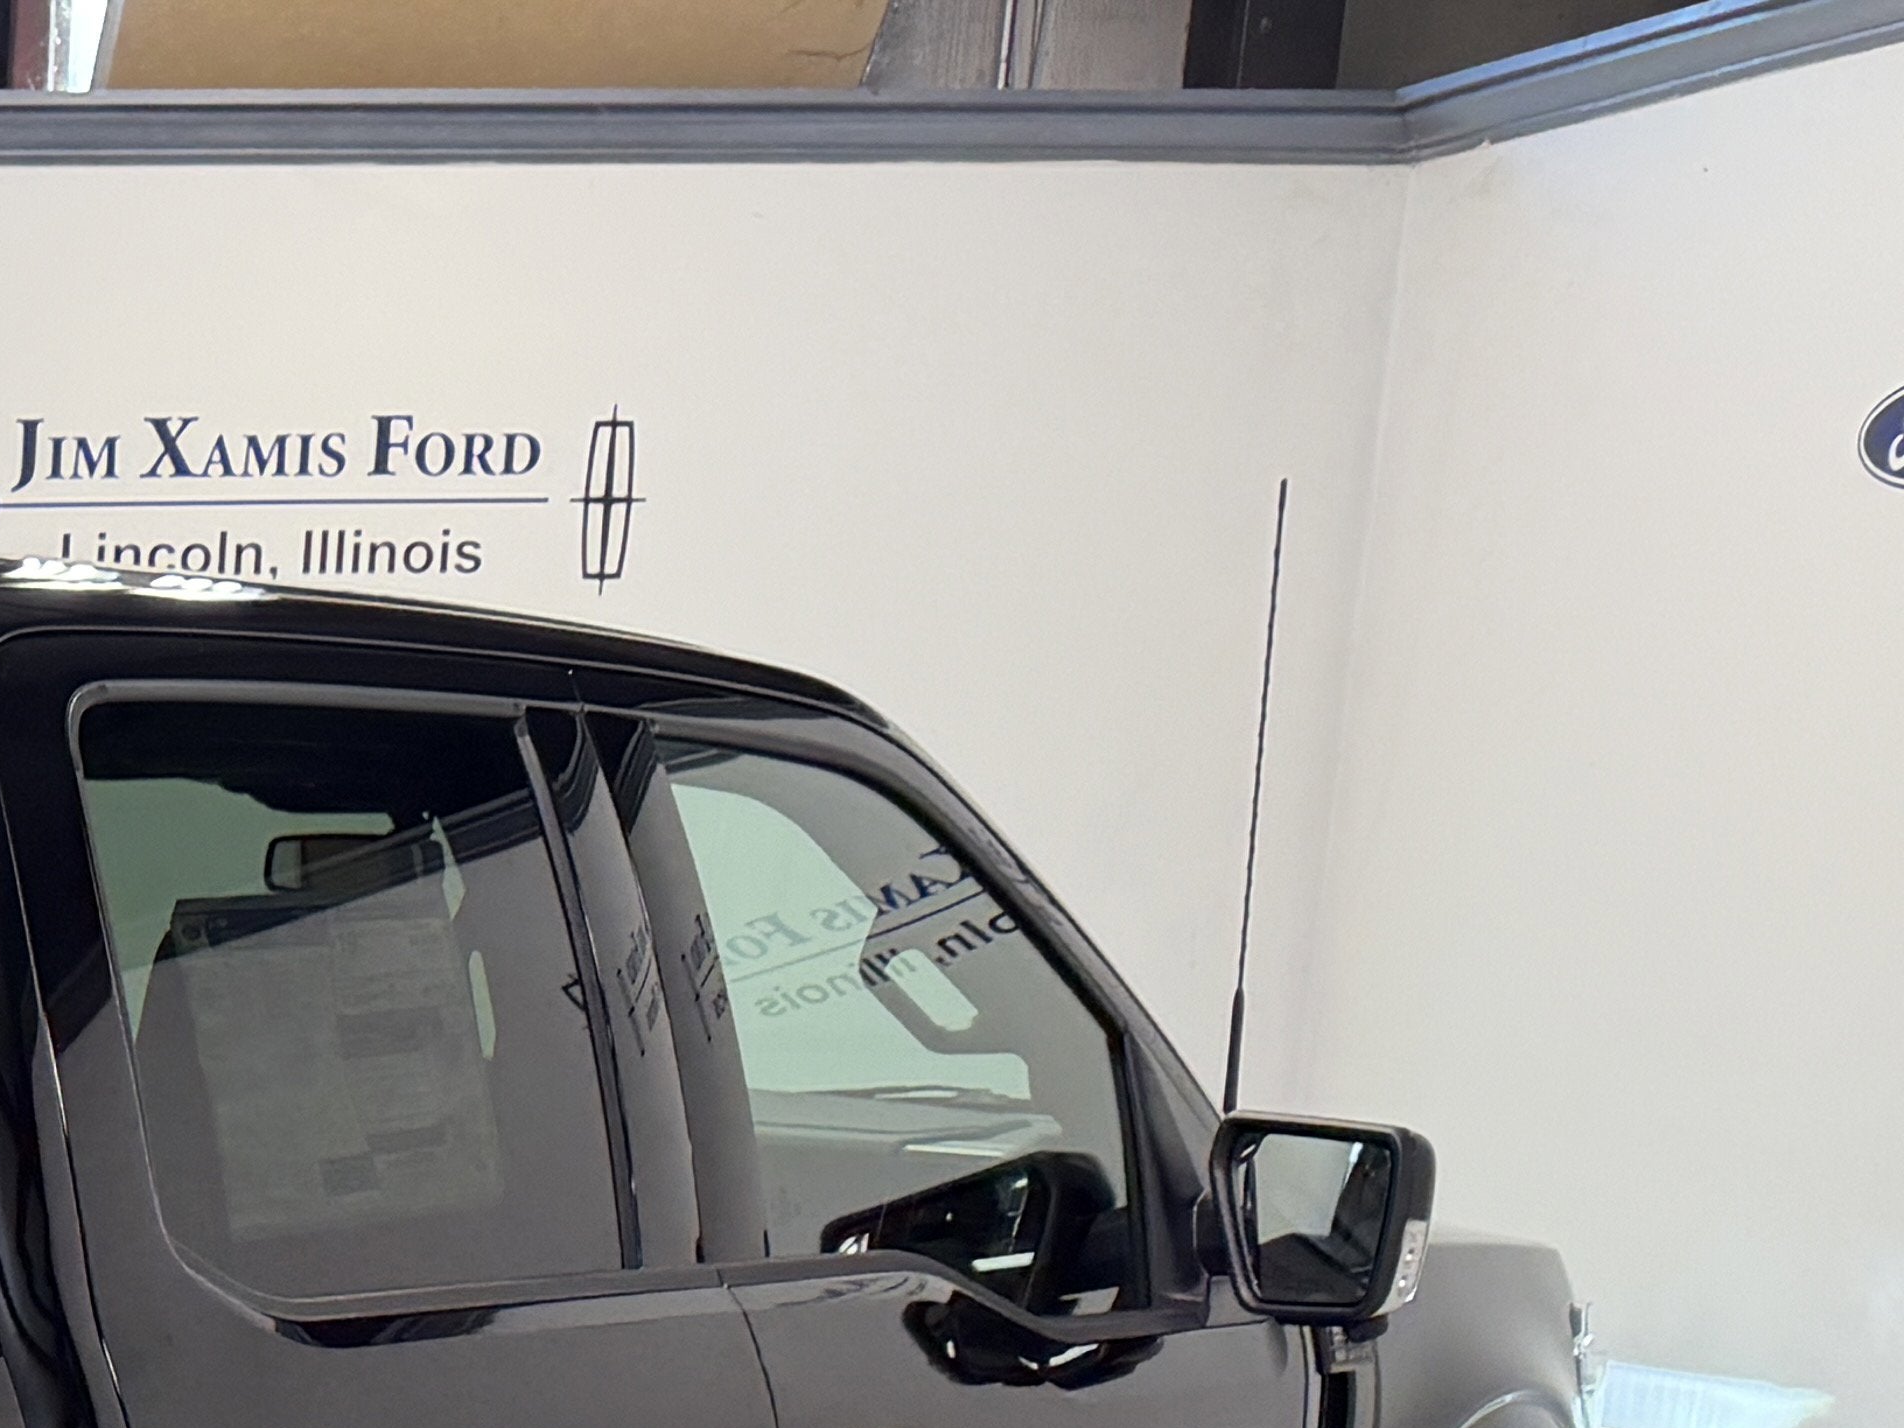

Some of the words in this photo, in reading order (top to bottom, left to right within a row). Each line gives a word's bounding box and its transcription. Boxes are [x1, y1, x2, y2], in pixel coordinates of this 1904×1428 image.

[12, 417, 119, 492] JIM
[140, 415, 346, 479] XAMIS
[367, 414, 542, 478] FORD
[300, 530, 484, 577] Illinois
